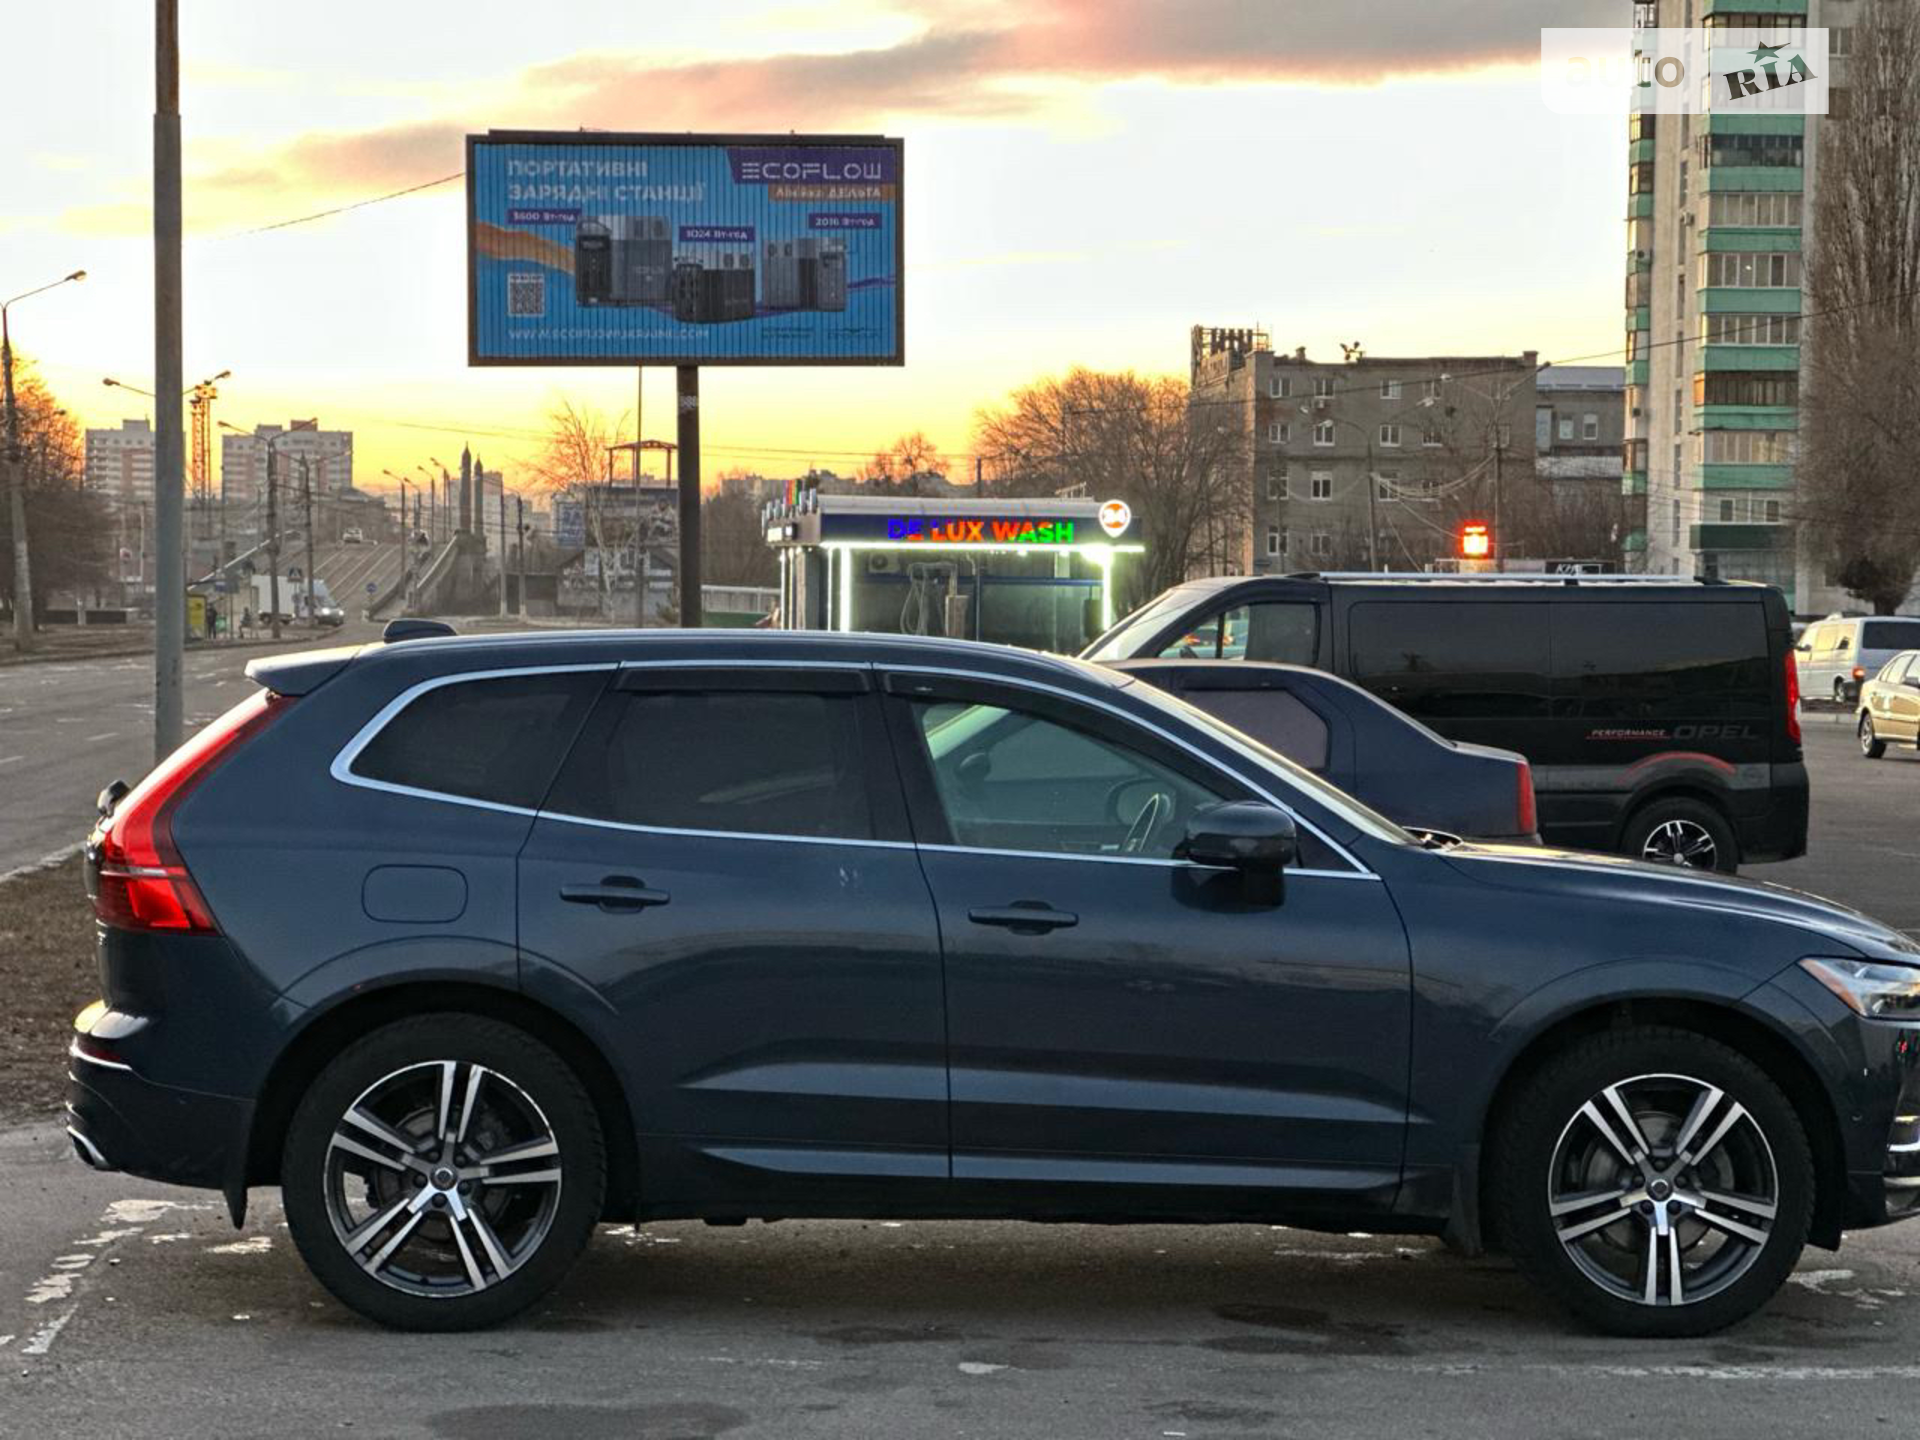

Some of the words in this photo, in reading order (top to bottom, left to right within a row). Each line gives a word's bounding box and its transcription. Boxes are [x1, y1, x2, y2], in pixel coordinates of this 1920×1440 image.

[508, 161, 649, 177] ПОРТАТИВНІ
[741, 162, 882, 180] ECOFLOW
[508, 184, 606, 203] ЗАРЯДНІ
[615, 181, 707, 204] СТАНЦІЇ
[888, 519, 924, 541] DE
[930, 519, 985, 543] LUX
[990, 519, 1075, 543] WASH
[1591, 728, 1667, 738] PERFORMANCE
[1672, 725, 1760, 740] OPEL
